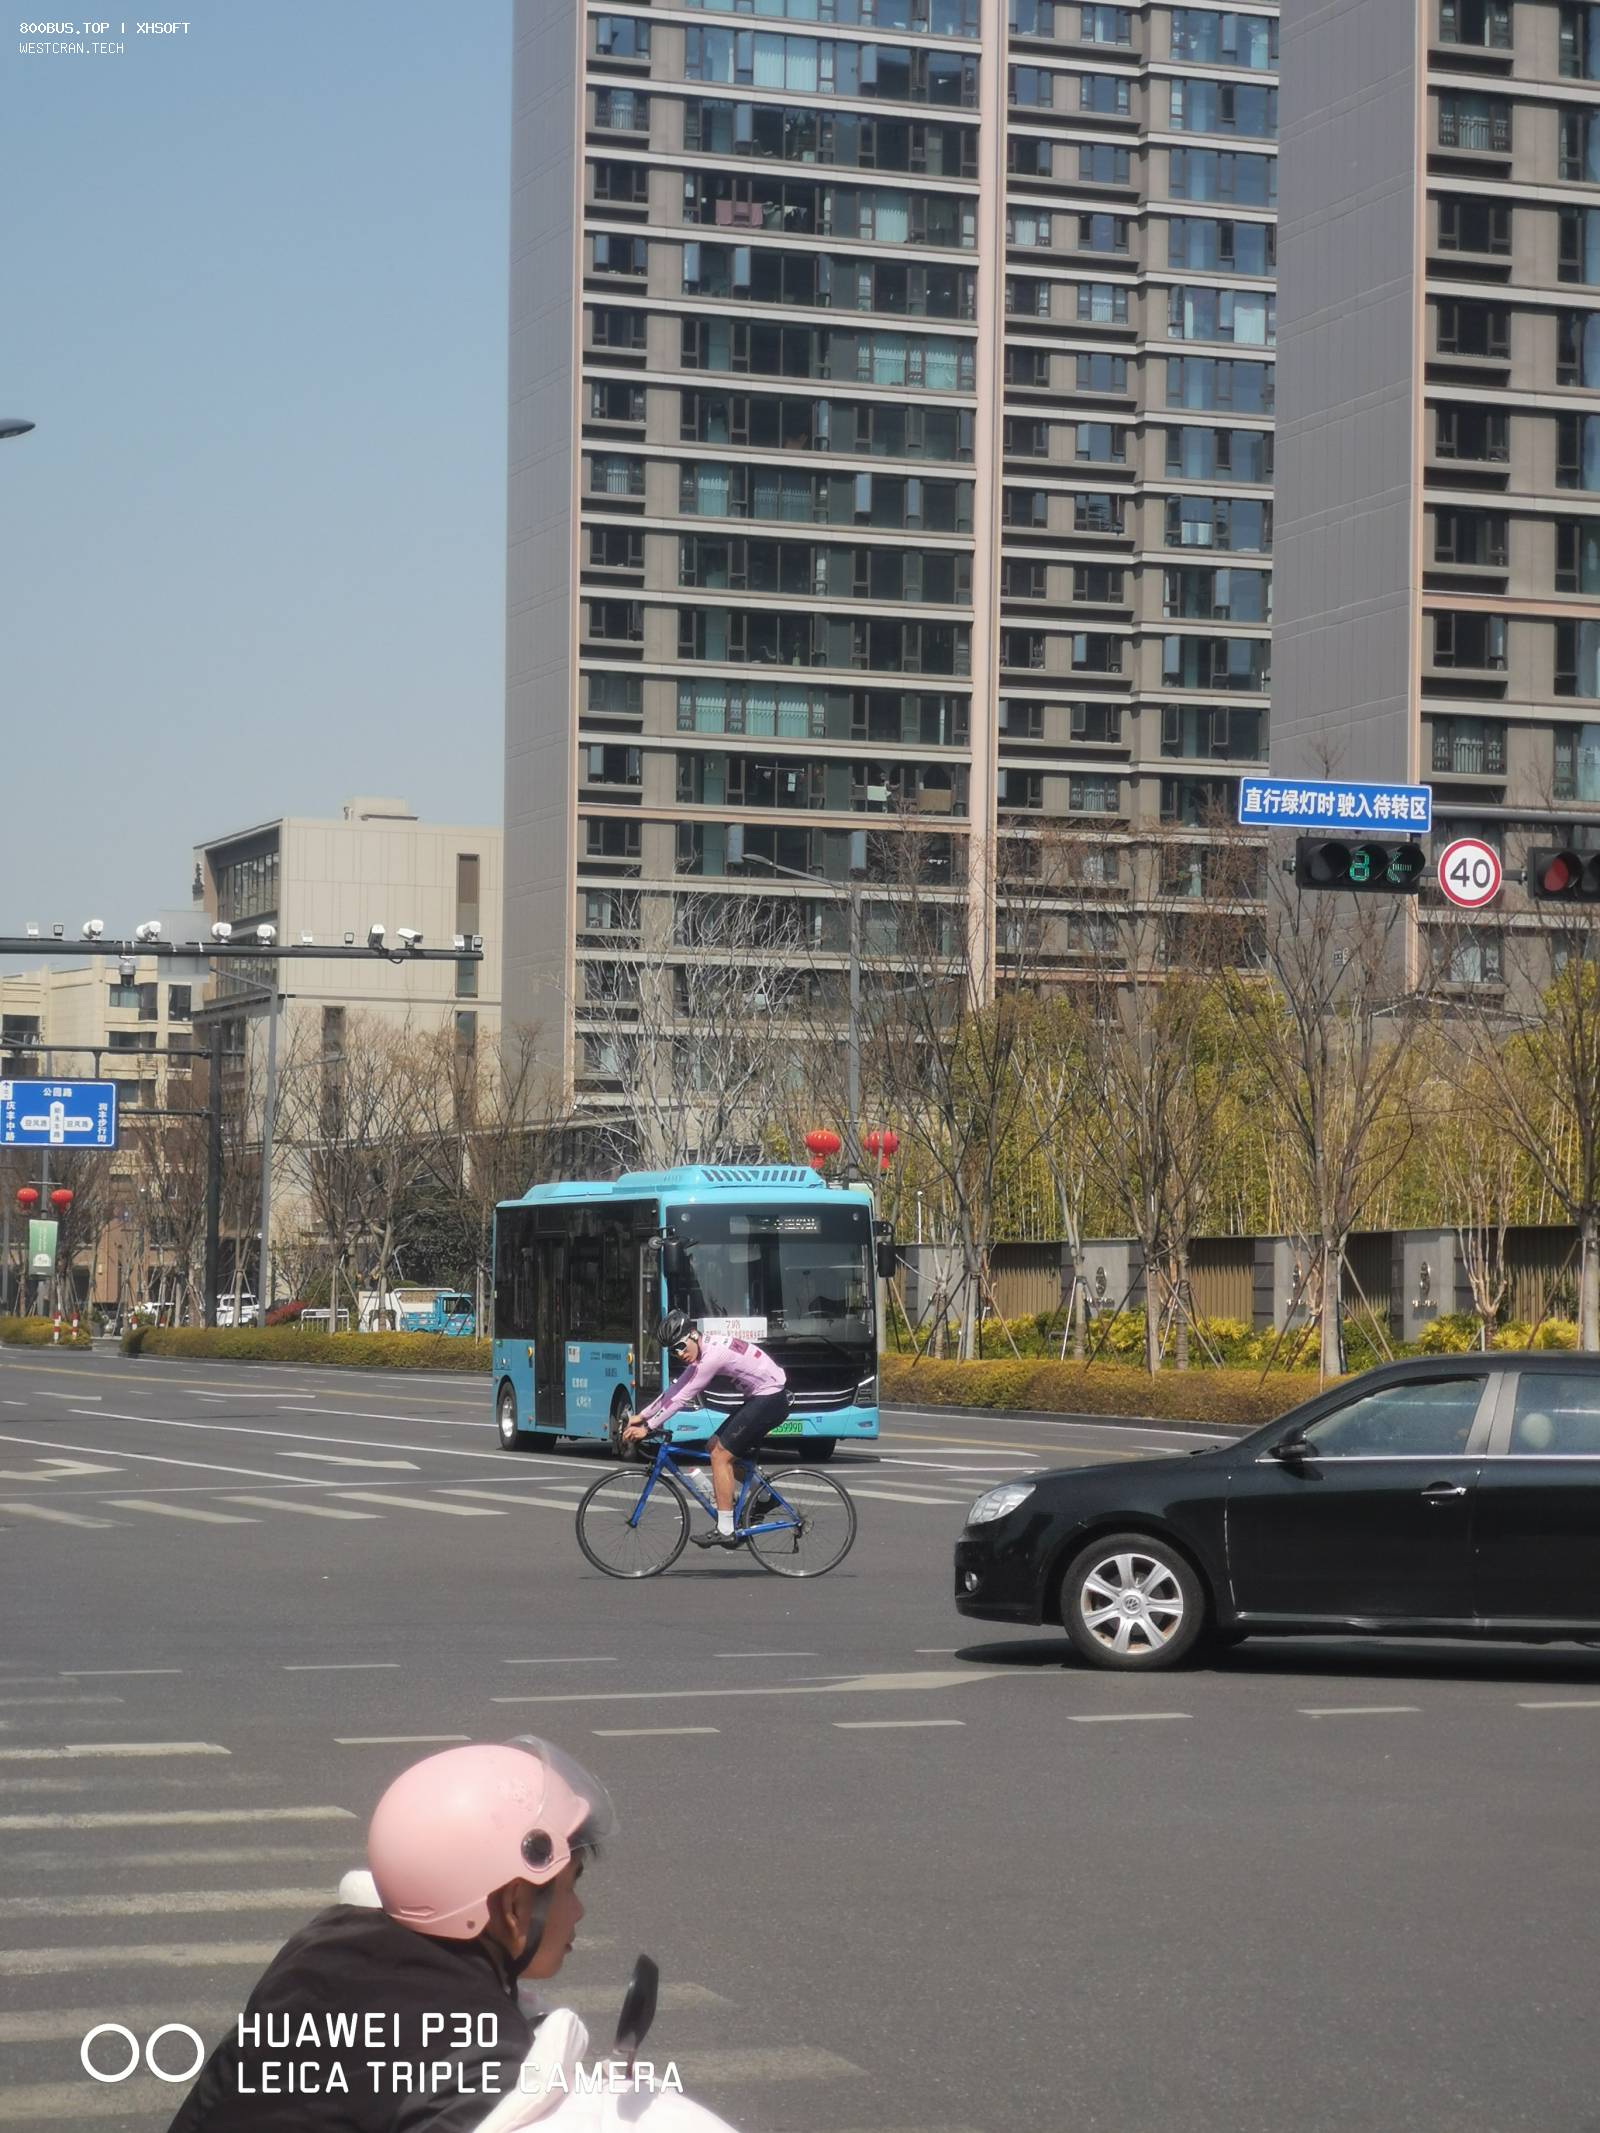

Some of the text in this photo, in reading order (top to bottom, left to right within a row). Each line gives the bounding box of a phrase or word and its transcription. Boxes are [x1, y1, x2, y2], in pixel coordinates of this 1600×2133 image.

[1244, 787, 1427, 820] 直行绿灯时驶入待转区
[1450, 858, 1491, 889] 40
[42, 1087, 72, 1097] 公园路
